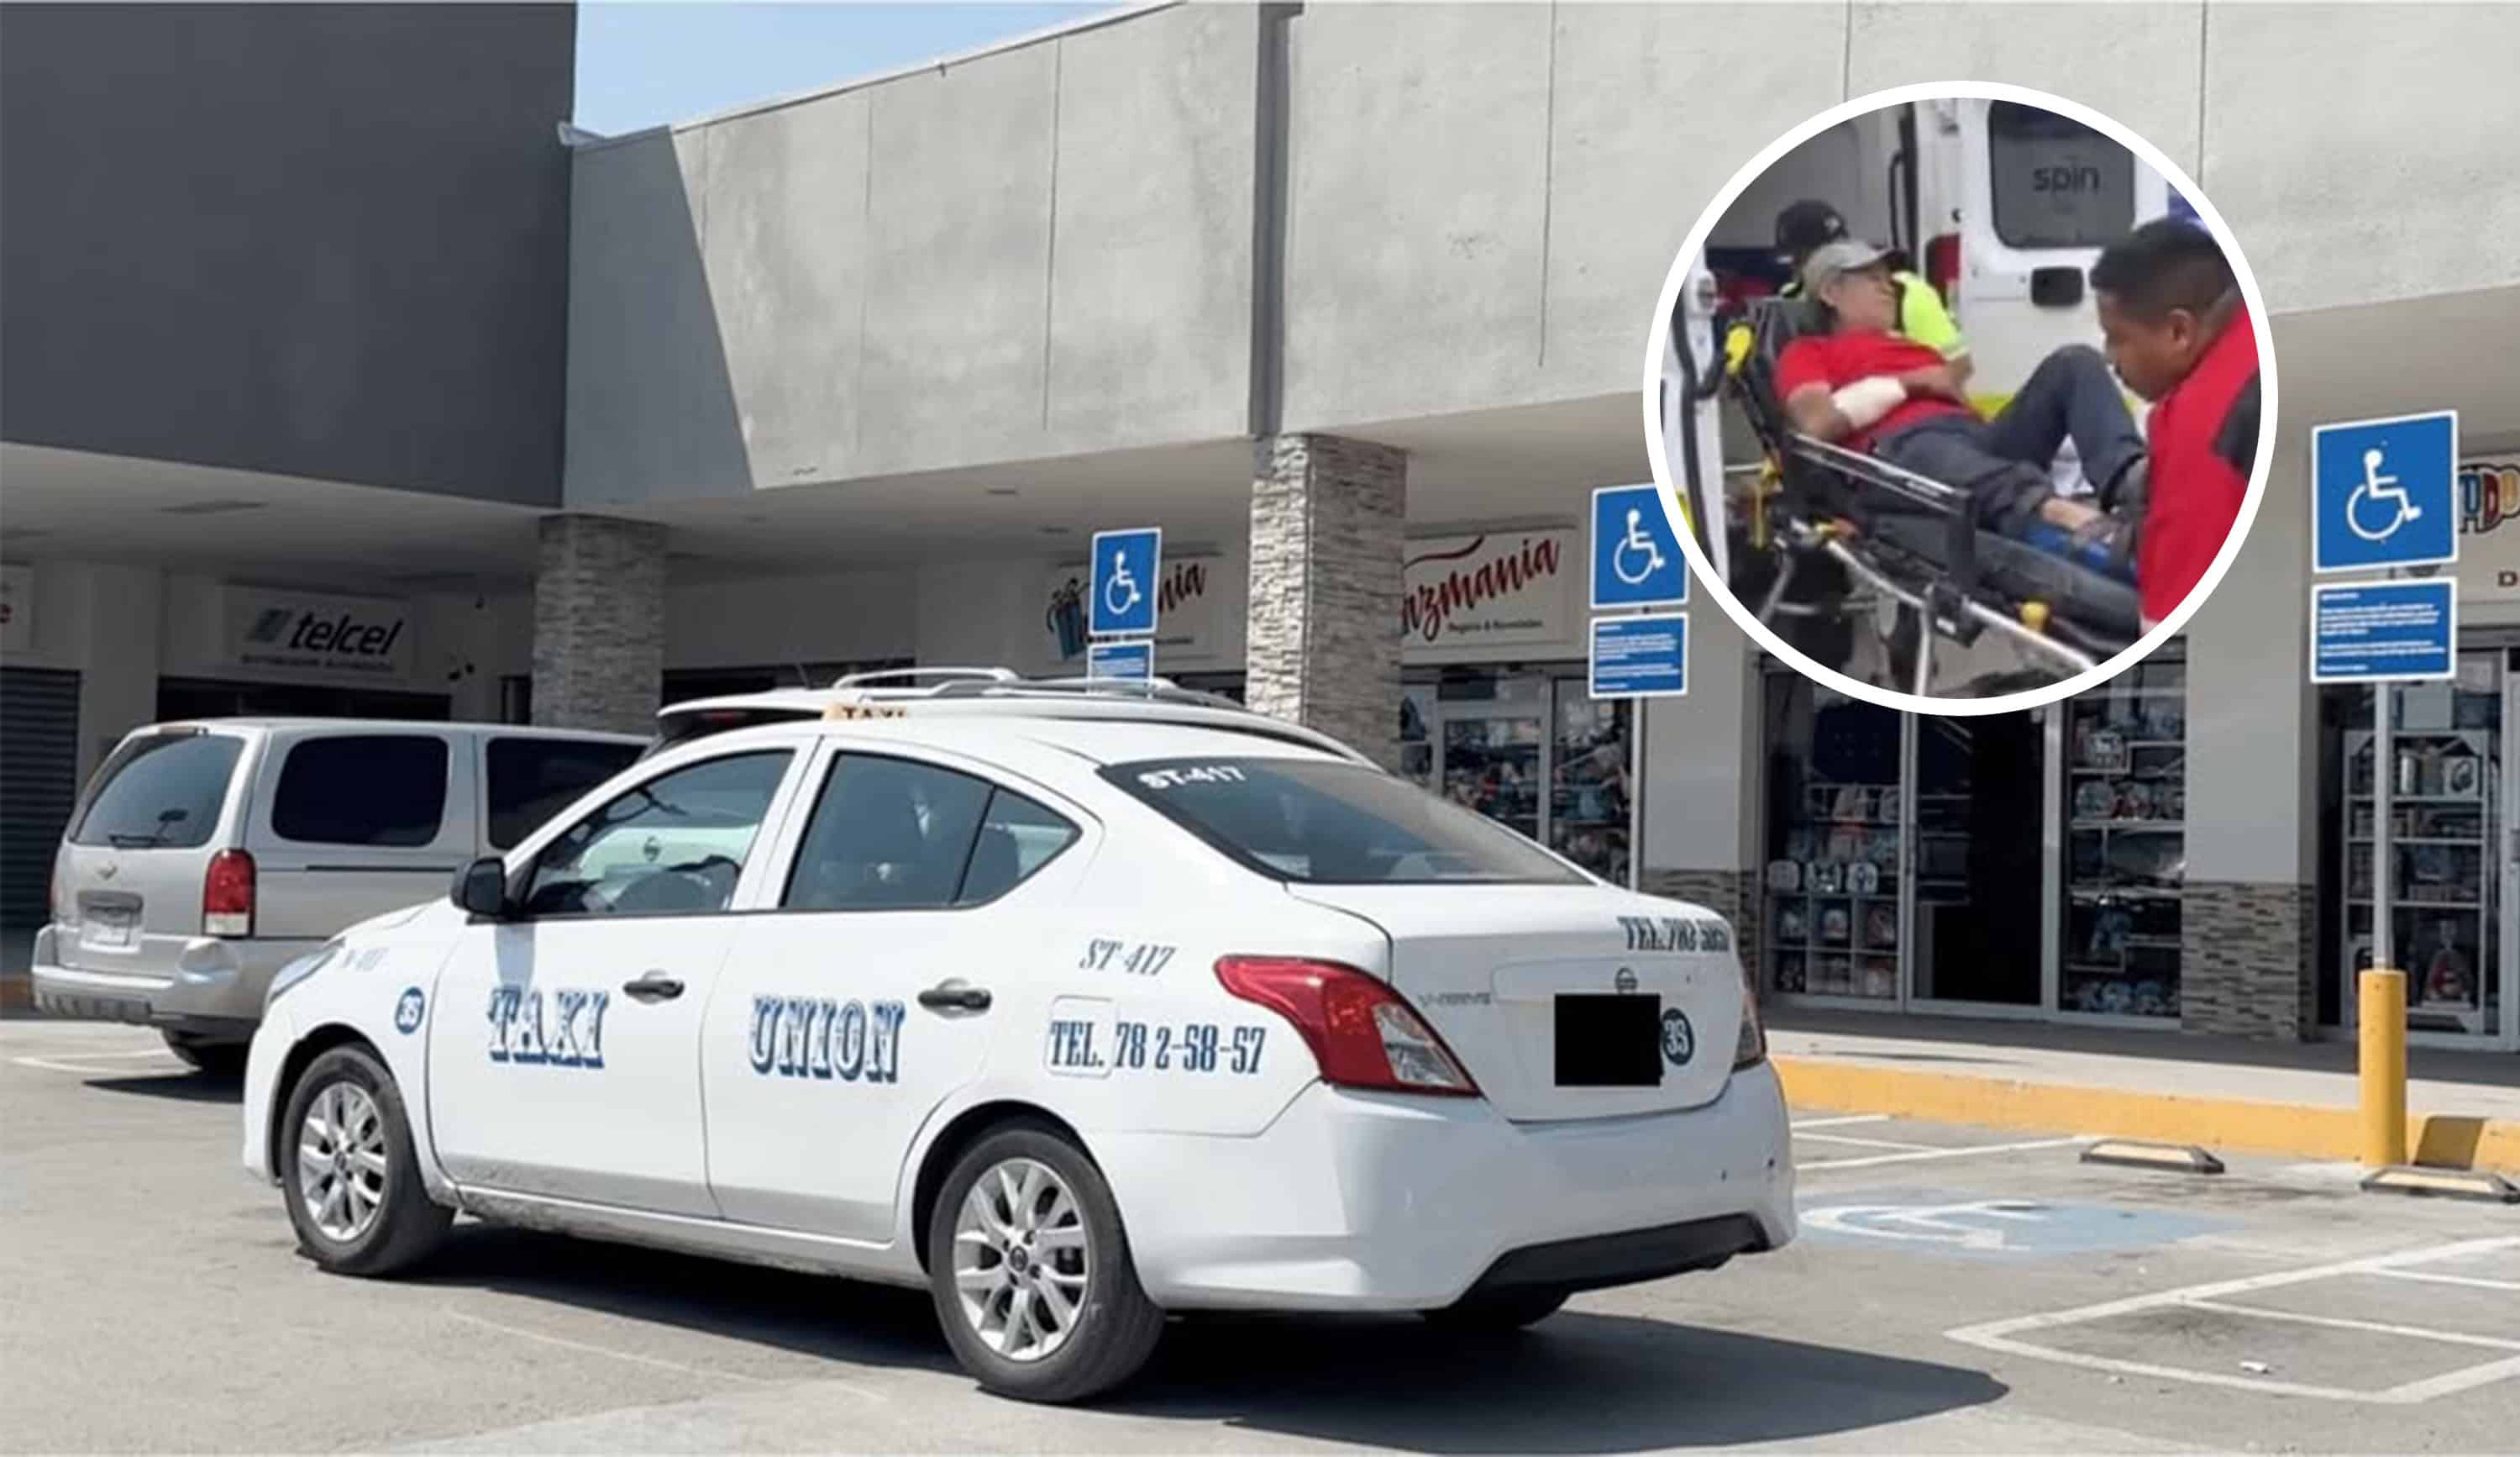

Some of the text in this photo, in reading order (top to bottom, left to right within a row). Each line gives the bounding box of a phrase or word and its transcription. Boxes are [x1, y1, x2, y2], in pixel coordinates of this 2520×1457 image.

[289, 612, 404, 655] telcel
[486, 986, 609, 1068] TAXI
[750, 996, 906, 1084] UNION
[1050, 1020, 1105, 1067] TEL.
[1115, 1022, 1147, 1069] 78
